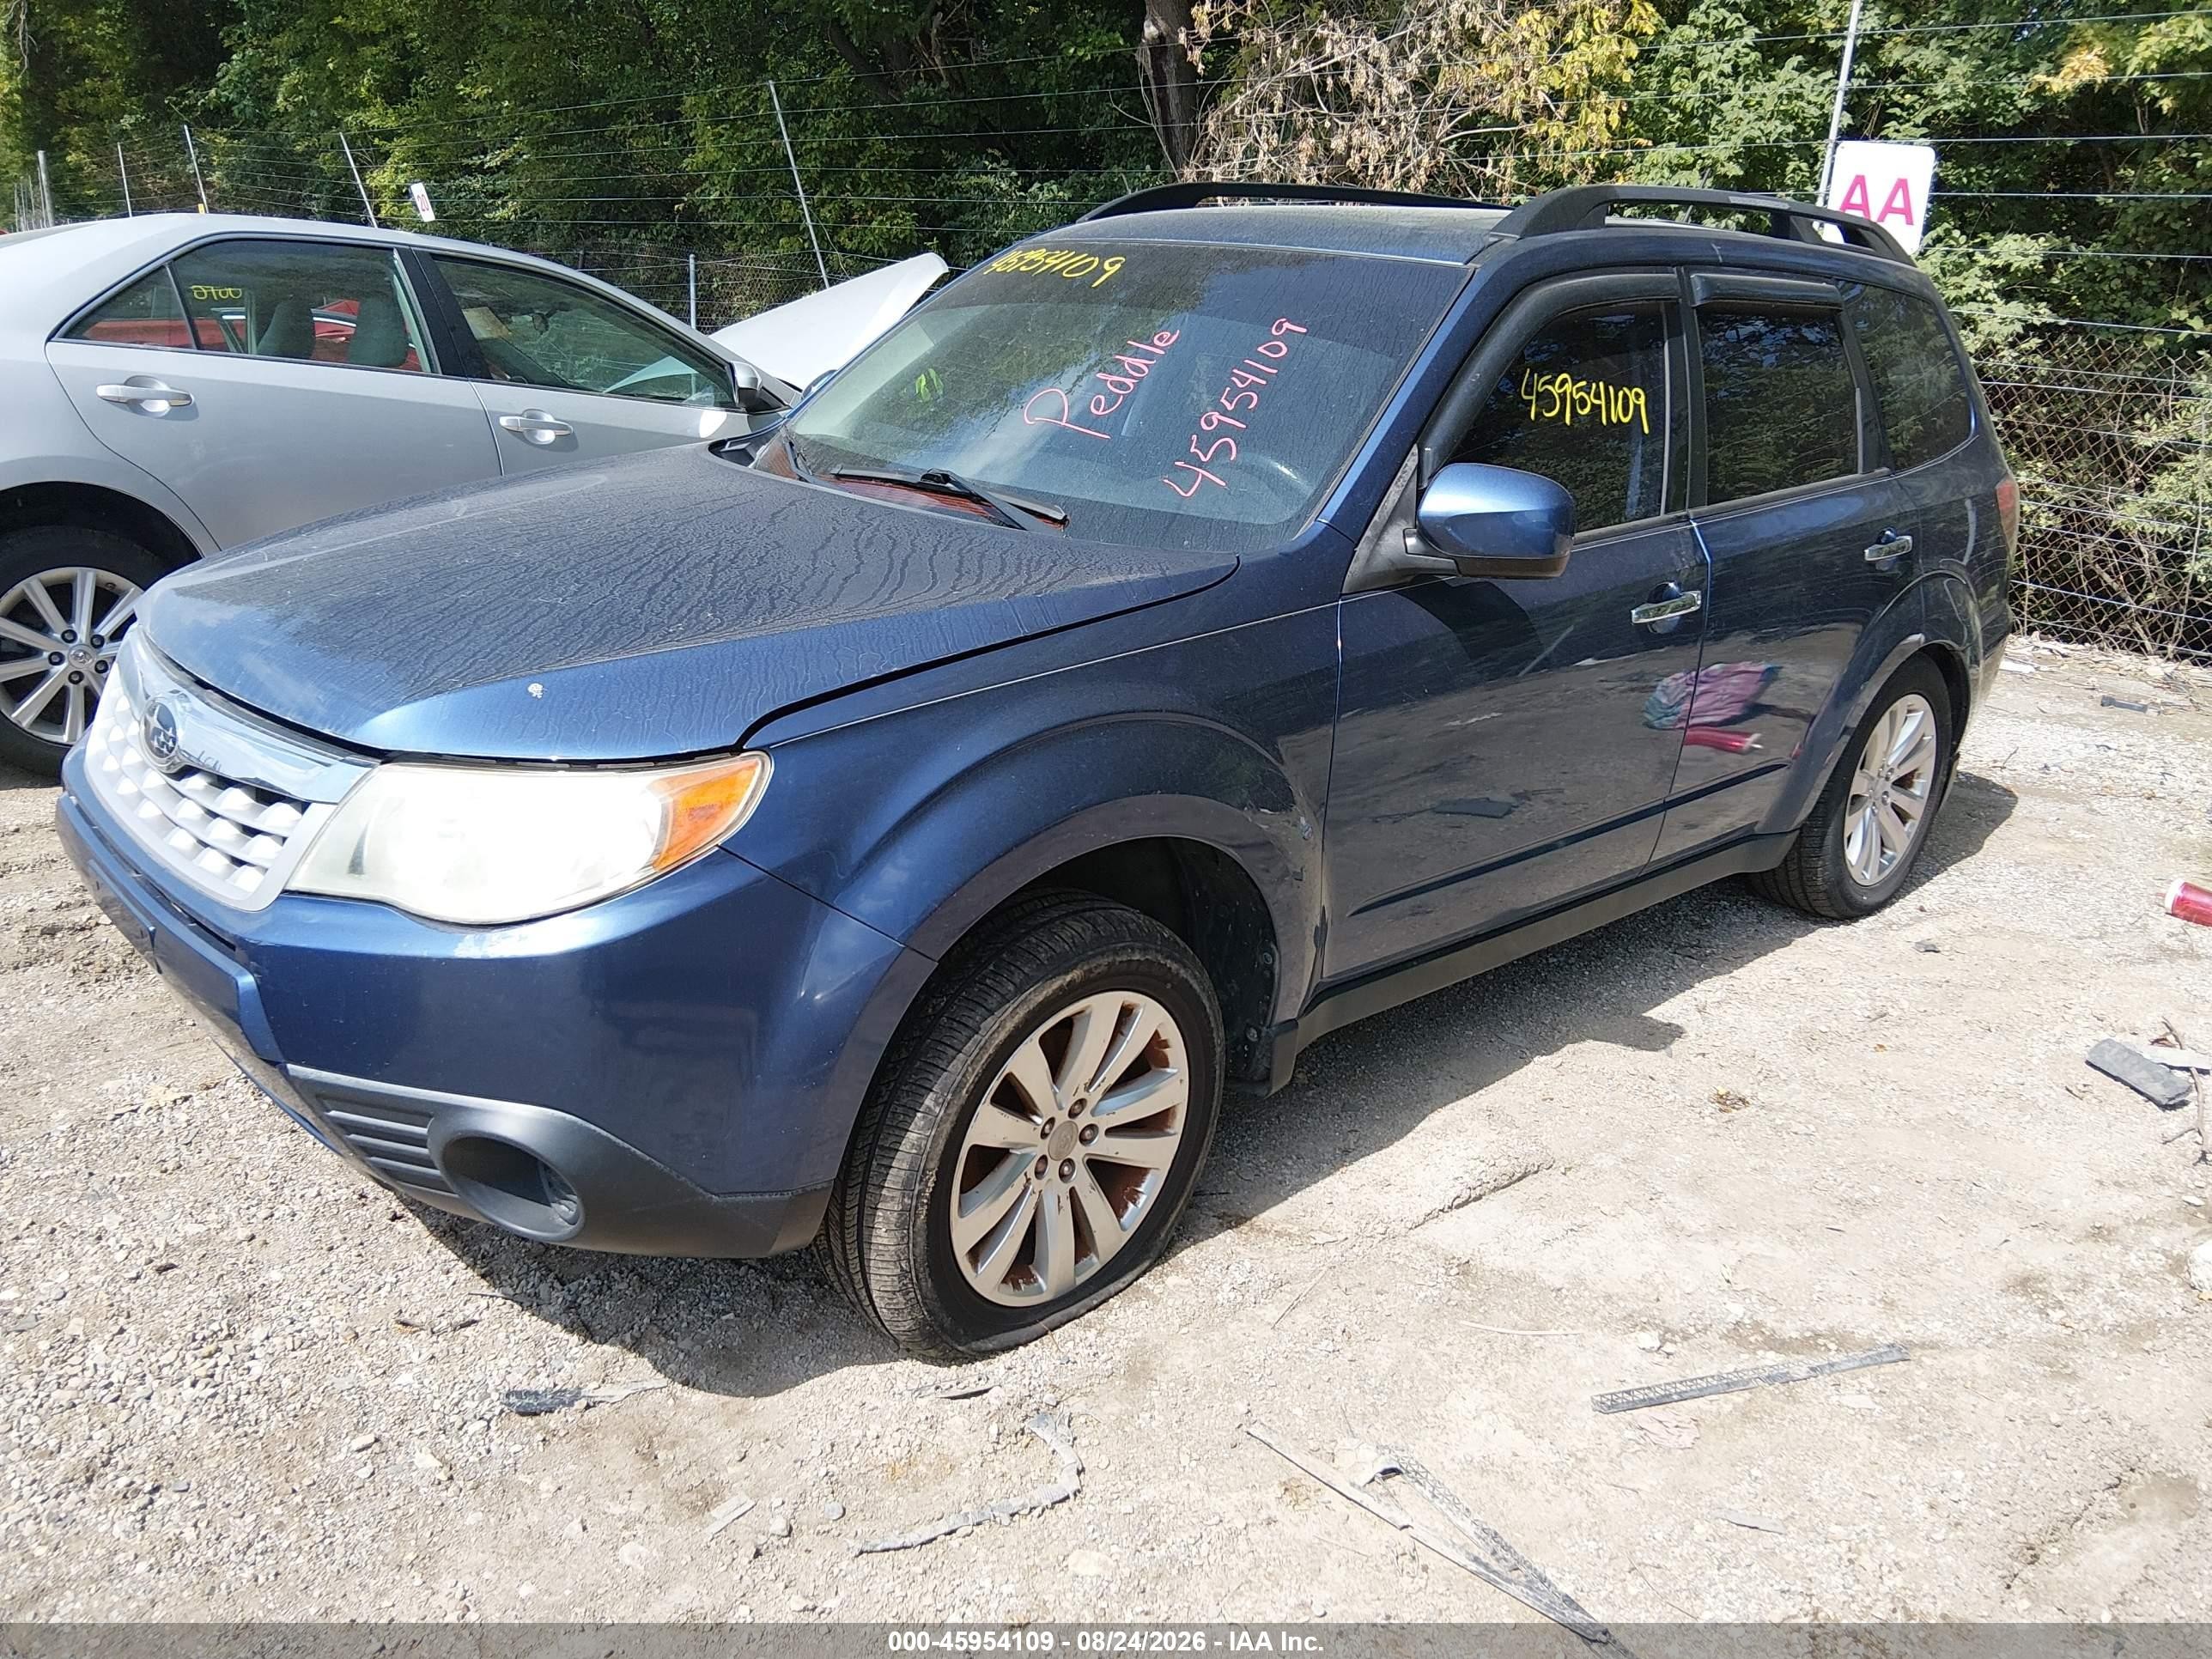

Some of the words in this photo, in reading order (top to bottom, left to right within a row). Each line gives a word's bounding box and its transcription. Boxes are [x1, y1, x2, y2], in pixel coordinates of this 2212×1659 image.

[1839, 174, 1914, 226] AA
[1024, 329, 1181, 440] Peddle
[1163, 318, 1308, 497] 45954109
[1521, 368, 1650, 434] 45954109
